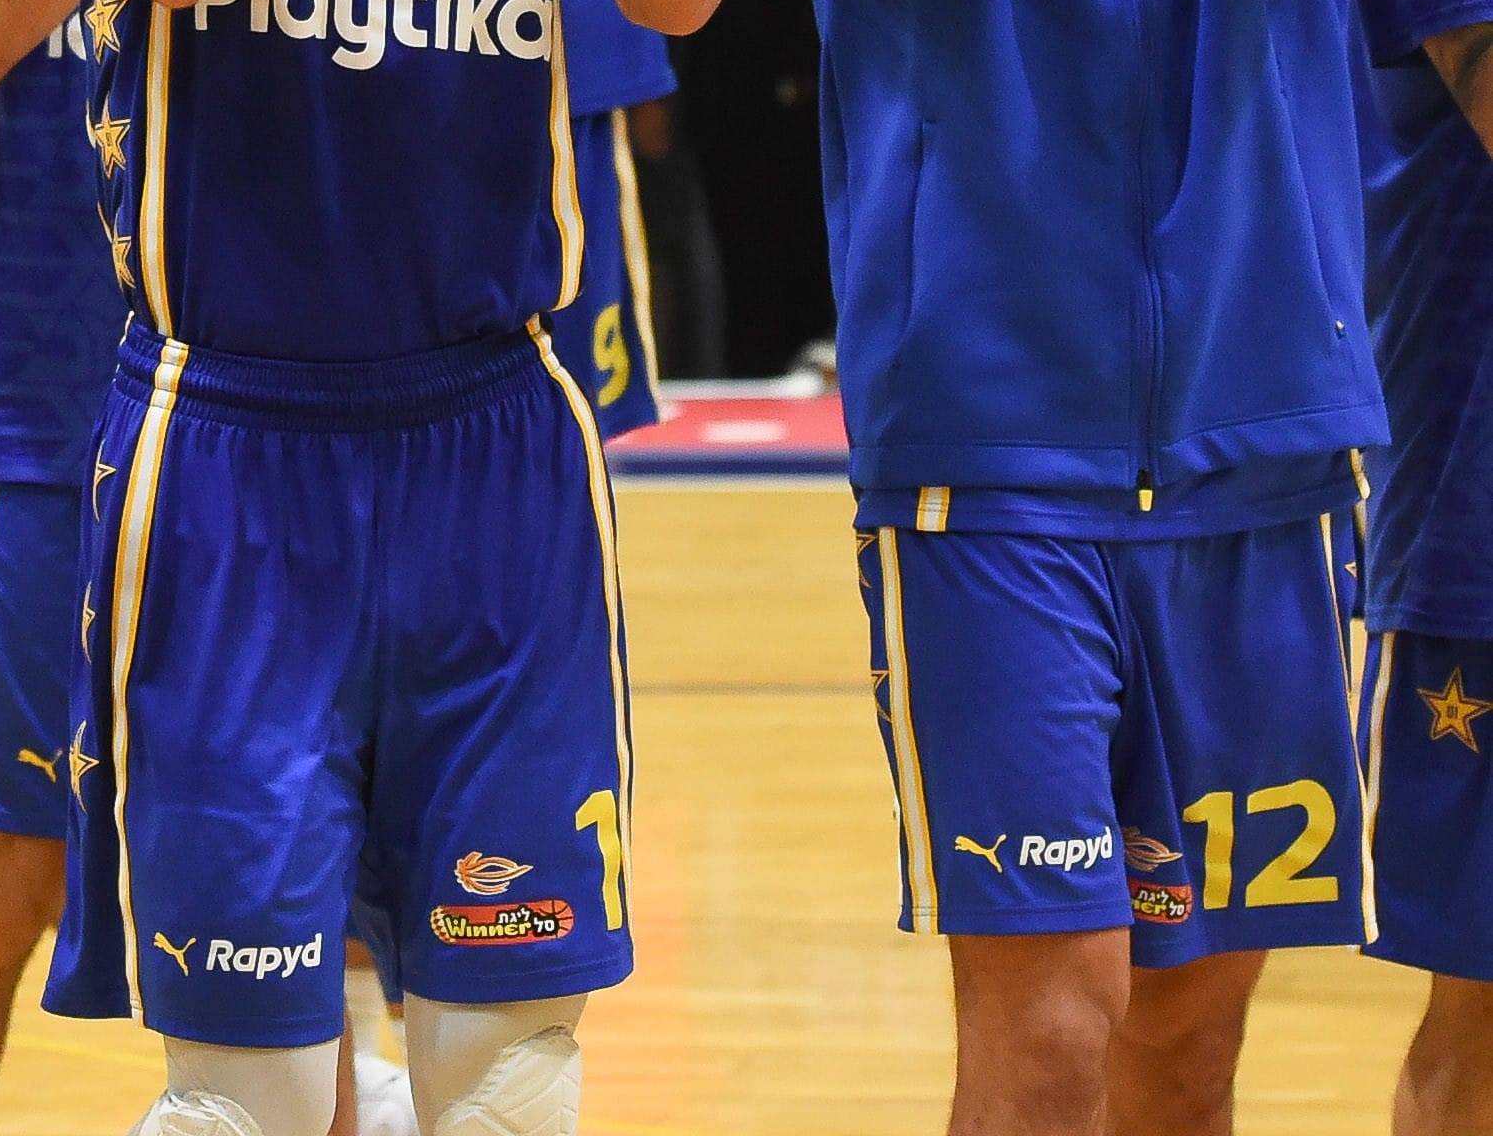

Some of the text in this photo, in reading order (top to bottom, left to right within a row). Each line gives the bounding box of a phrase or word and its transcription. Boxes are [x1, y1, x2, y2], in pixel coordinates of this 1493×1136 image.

[593, 303, 631, 408] 9
[575, 790, 624, 931] 1
[1018, 825, 1113, 872] Rapyd
[1182, 778, 1339, 910] 12
[206, 933, 323, 980] Rapyd
[444, 915, 556, 938] Winner סל
